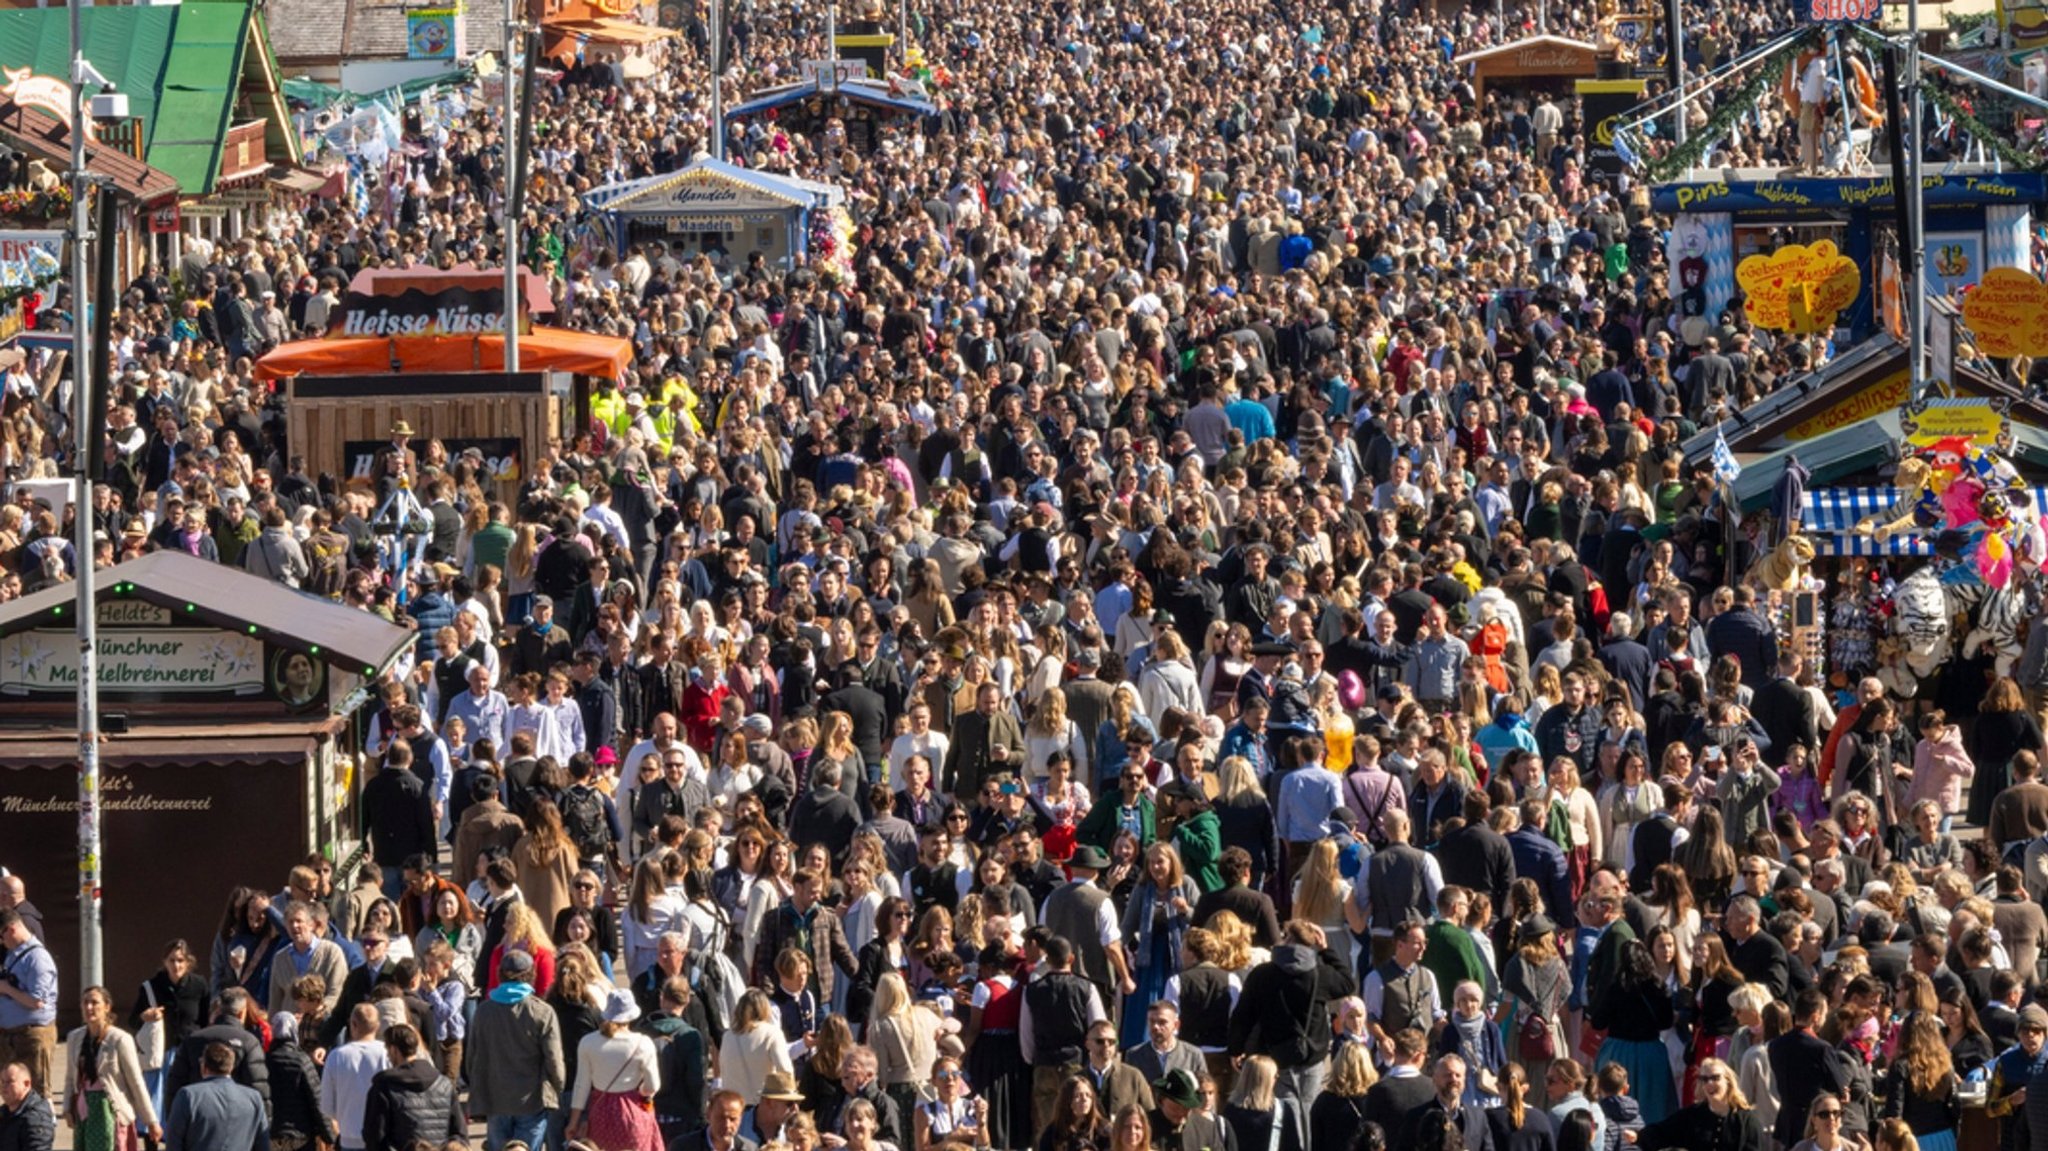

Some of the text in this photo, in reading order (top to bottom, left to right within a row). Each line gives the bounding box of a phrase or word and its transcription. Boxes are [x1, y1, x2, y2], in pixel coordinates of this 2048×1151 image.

[1811, 0, 1878, 20] SHOP
[672, 187, 737, 204] Mandeln
[1676, 180, 1729, 210] Pins
[1966, 177, 2017, 197] Tassen
[677, 218, 733, 231] Mandeln
[343, 307, 430, 336] Heisse
[98, 602, 162, 621] Heldt's
[96, 636, 183, 656] ünchner
[49, 663, 216, 683] Madelbrennerei
[98, 775, 133, 791] ldt's
[97, 794, 213, 811] andelbrennerei
